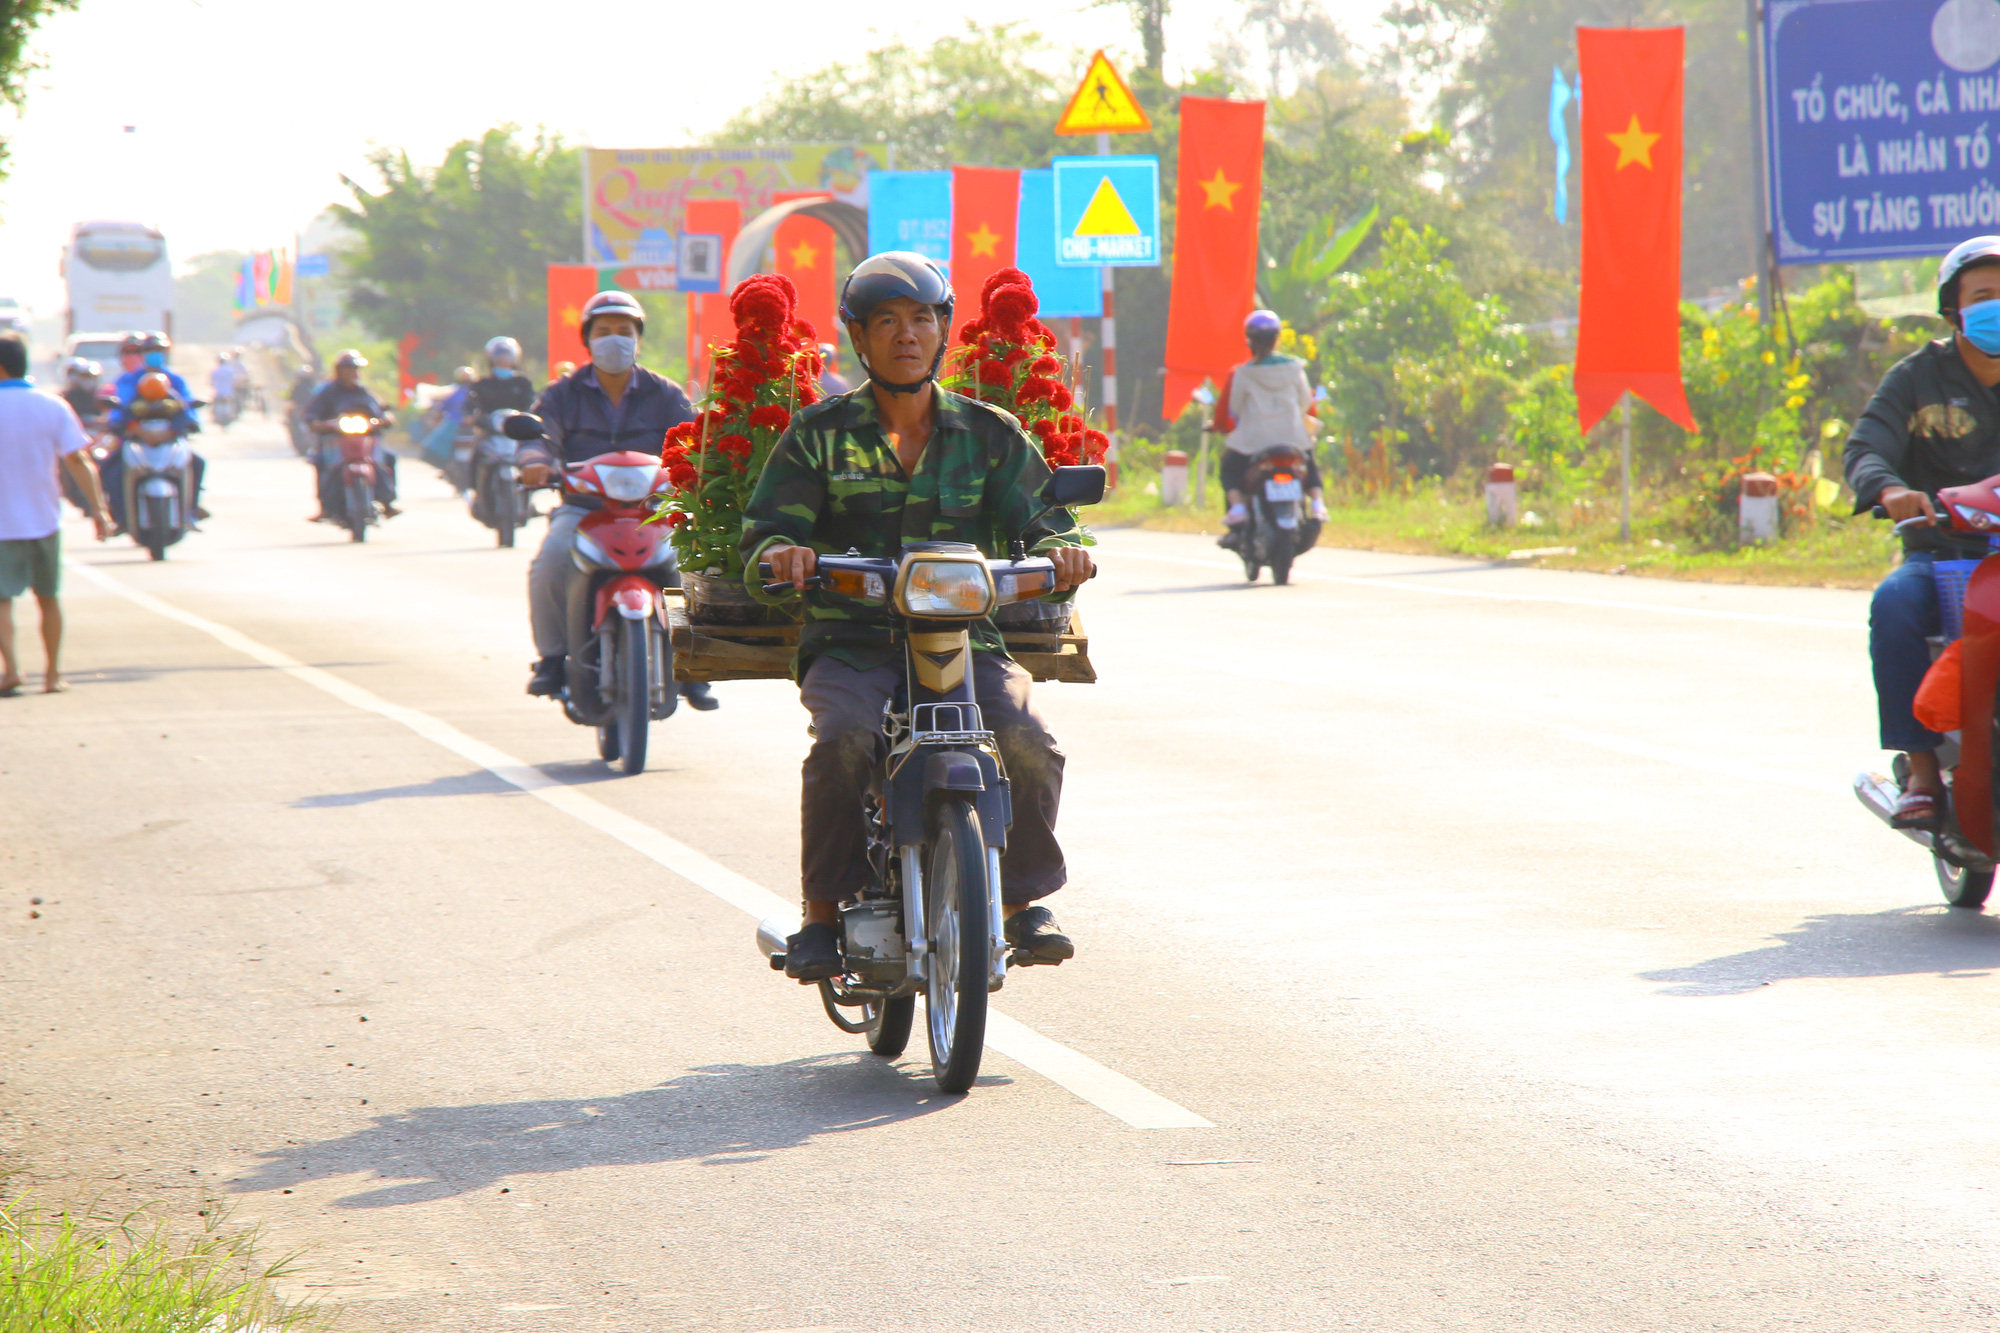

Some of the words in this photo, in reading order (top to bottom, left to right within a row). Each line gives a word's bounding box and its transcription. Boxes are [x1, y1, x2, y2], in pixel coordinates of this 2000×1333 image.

[1834, 73, 1909, 124] CHỨC,
[1915, 70, 1950, 115] CÁ
[1838, 134, 1870, 177] LÀ
[1878, 131, 1948, 174] NHÂN
[1954, 121, 1991, 169] TỐ
[1812, 195, 1848, 241] SỰ
[1853, 191, 1921, 234] TĂNG
